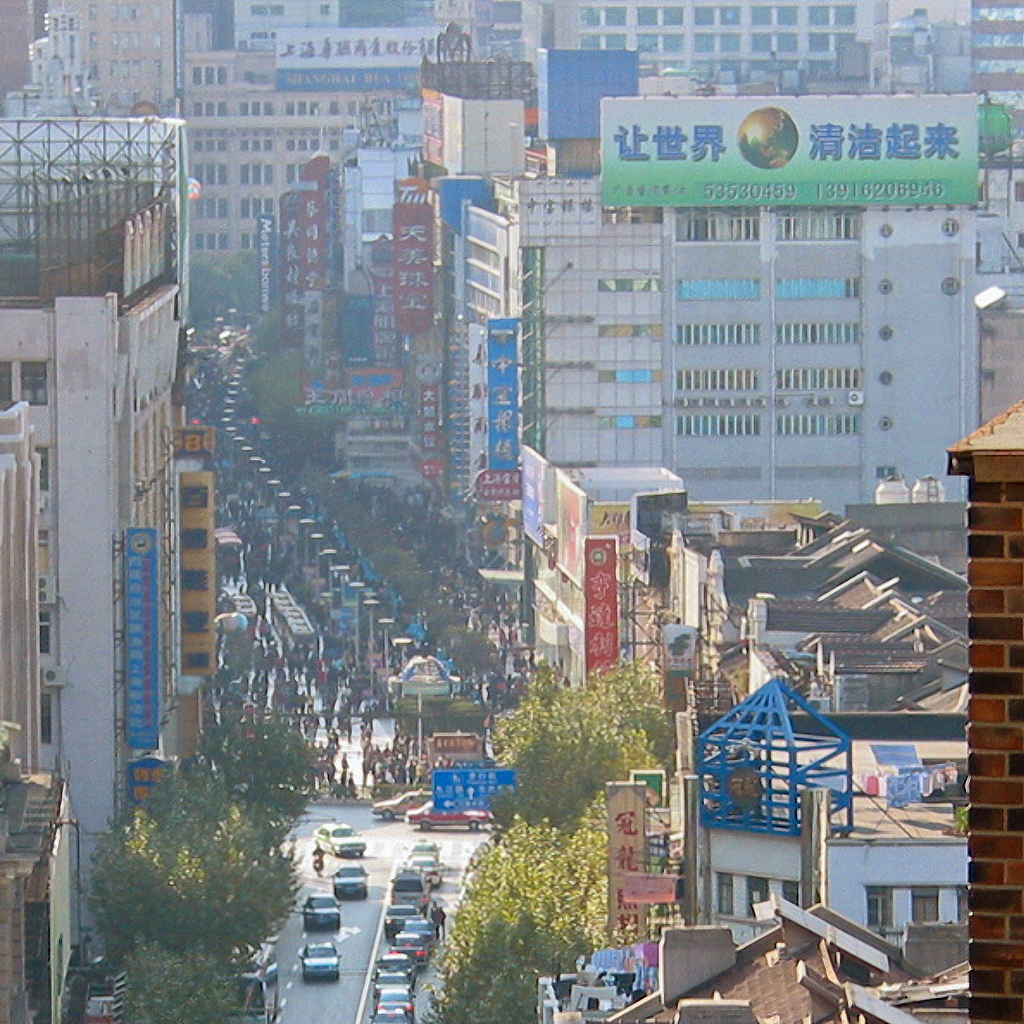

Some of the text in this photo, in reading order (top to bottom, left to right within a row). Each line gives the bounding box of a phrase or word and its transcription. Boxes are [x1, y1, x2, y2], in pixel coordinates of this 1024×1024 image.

[613, 123, 961, 162] 让世界 清洁起来
